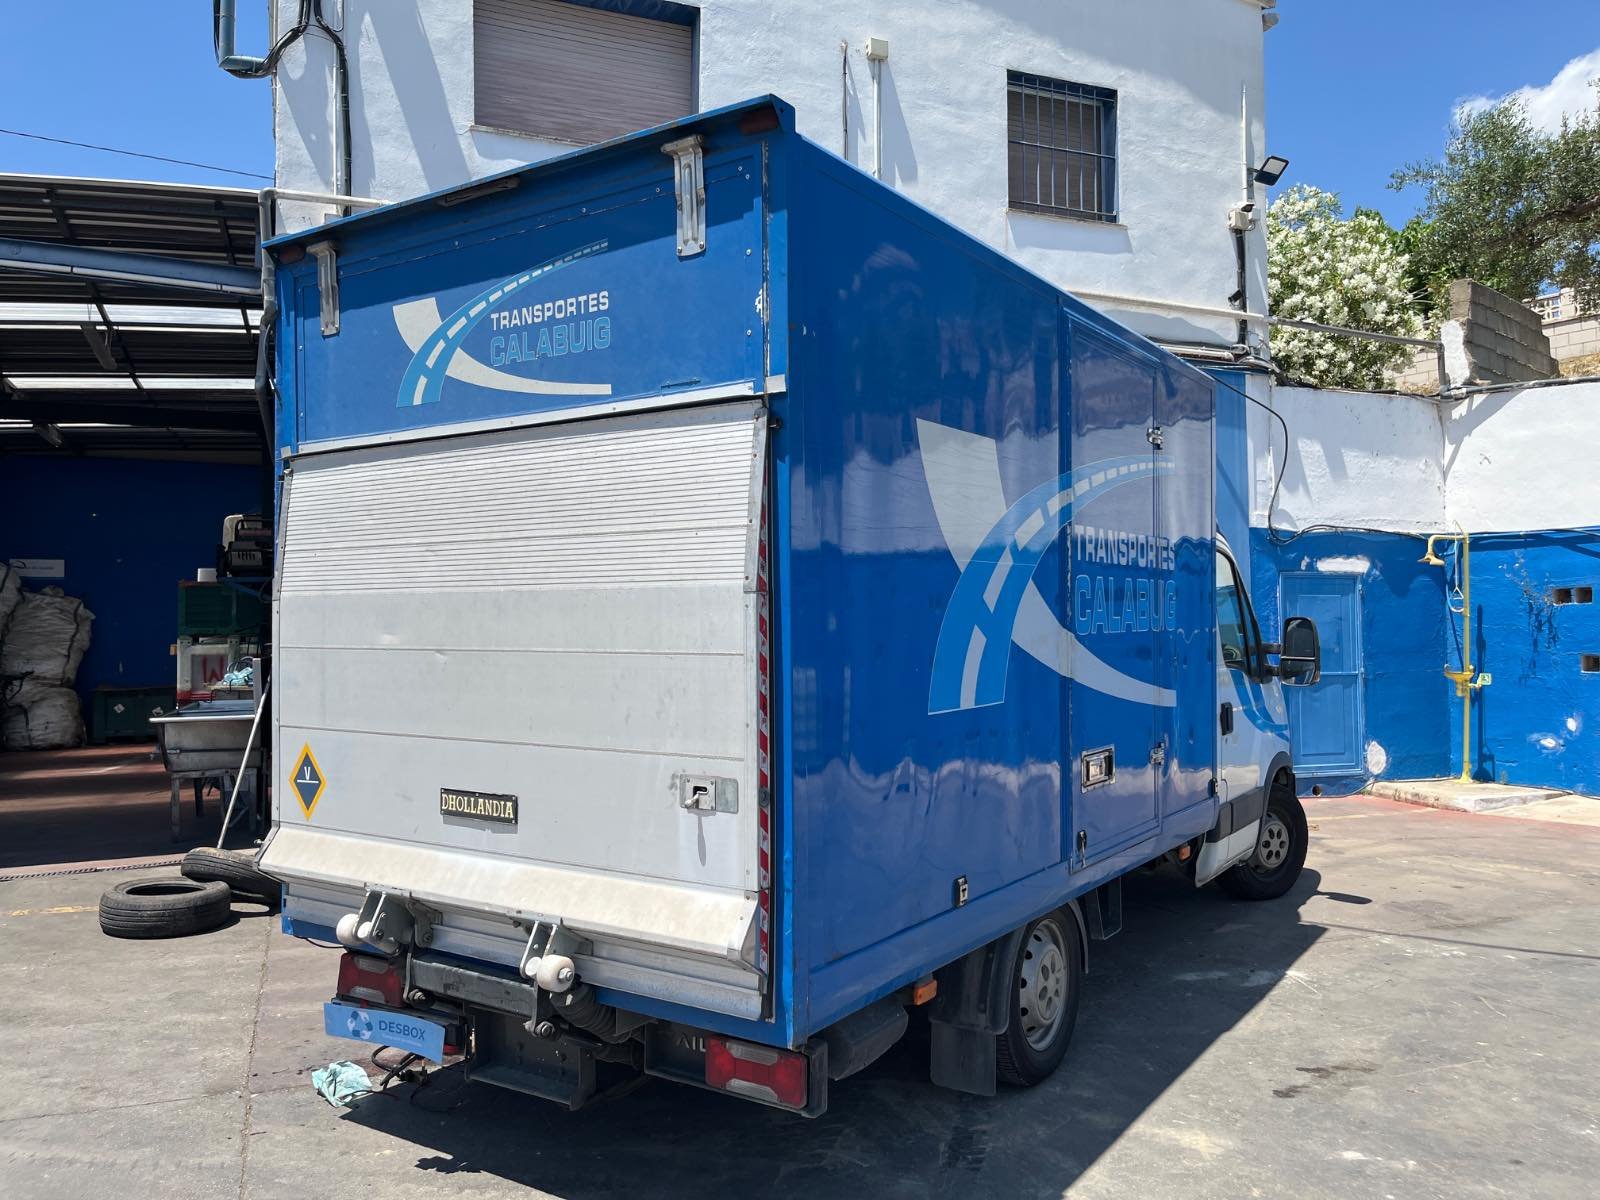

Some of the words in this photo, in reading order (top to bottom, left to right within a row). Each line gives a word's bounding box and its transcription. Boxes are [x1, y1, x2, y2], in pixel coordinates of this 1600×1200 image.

[490, 291, 609, 331] TRANSPORTES
[490, 317, 611, 366] CALABUIG
[1074, 525, 1175, 571] TRANSPORTES
[441, 793, 514, 818] DHOLLANDIA
[378, 1020, 426, 1041] DESBOX
